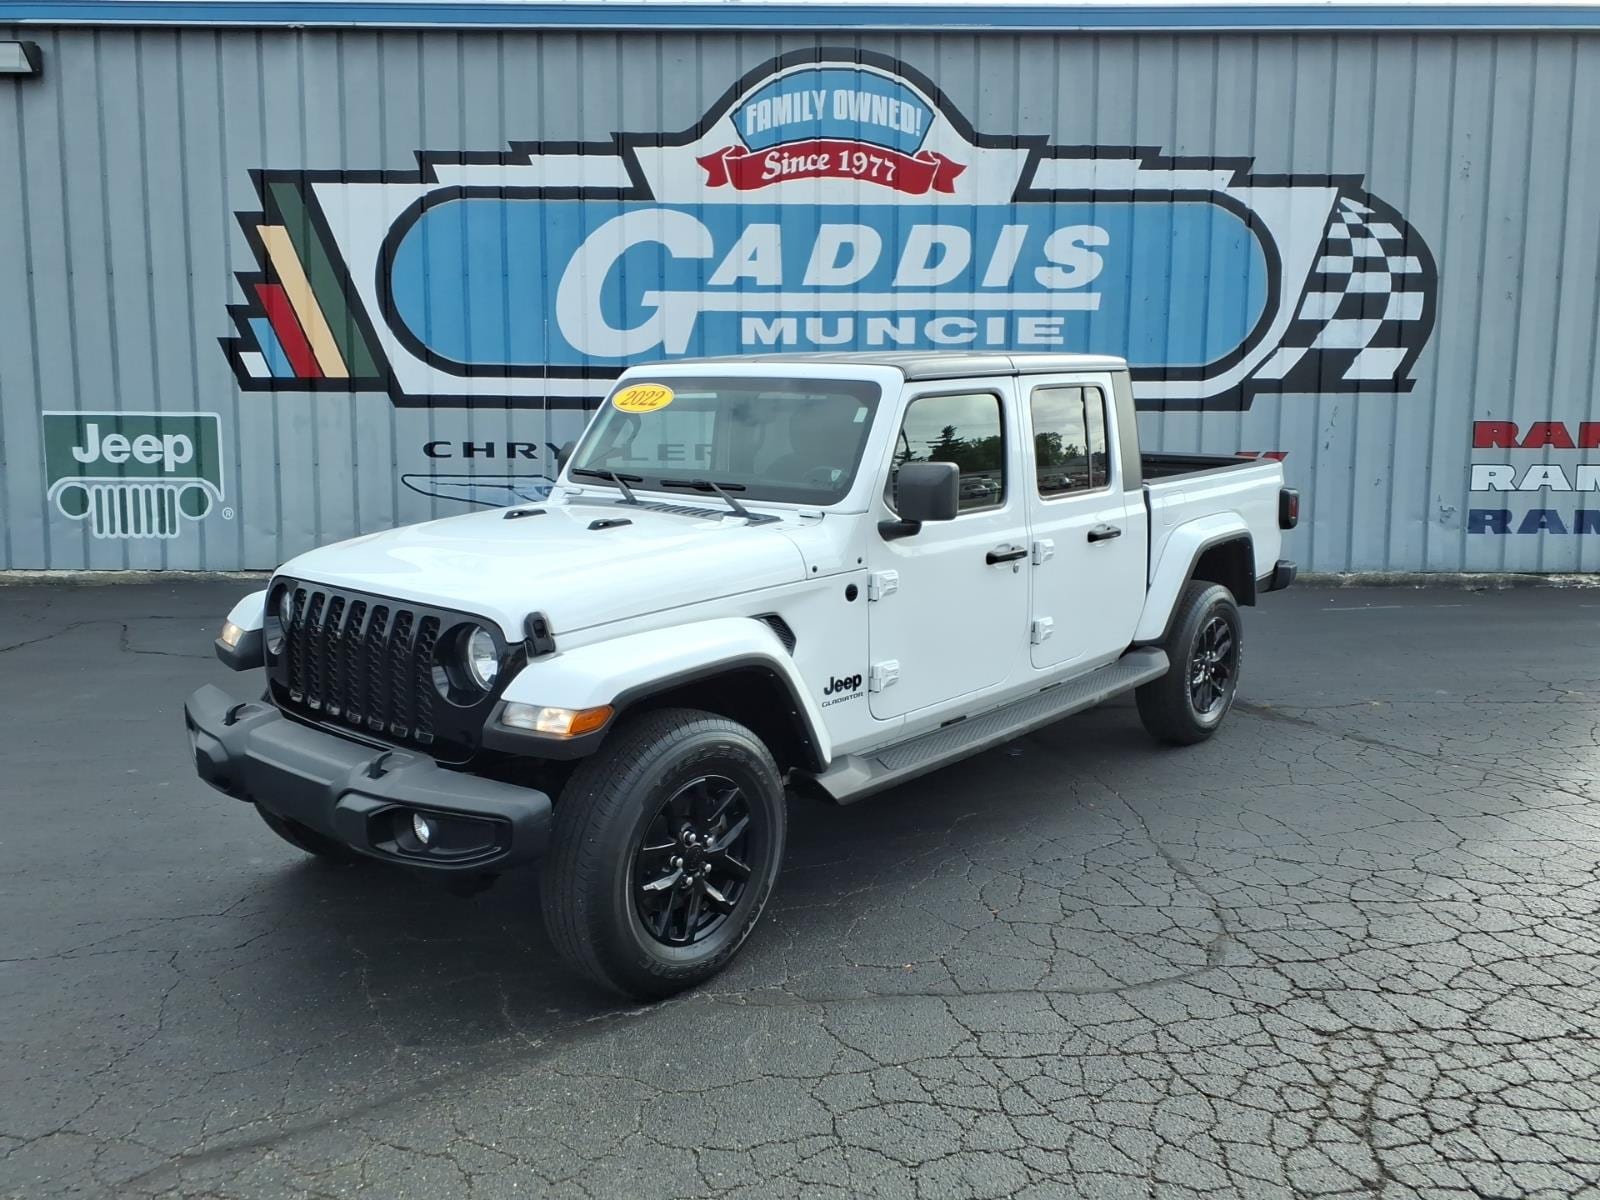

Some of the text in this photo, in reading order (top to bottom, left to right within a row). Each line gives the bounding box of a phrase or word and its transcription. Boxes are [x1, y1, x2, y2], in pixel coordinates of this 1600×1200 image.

[746, 89, 922, 137] FAMILY OWNED!
[761, 150, 897, 181] Since 1977
[556, 208, 1110, 357] GADDIS
[742, 317, 1065, 344] MUNCIE
[619, 390, 666, 406] 2022
[72, 423, 193, 472] Jeep
[823, 673, 862, 695] Jeep
[821, 691, 864, 708] GLADIATOR
